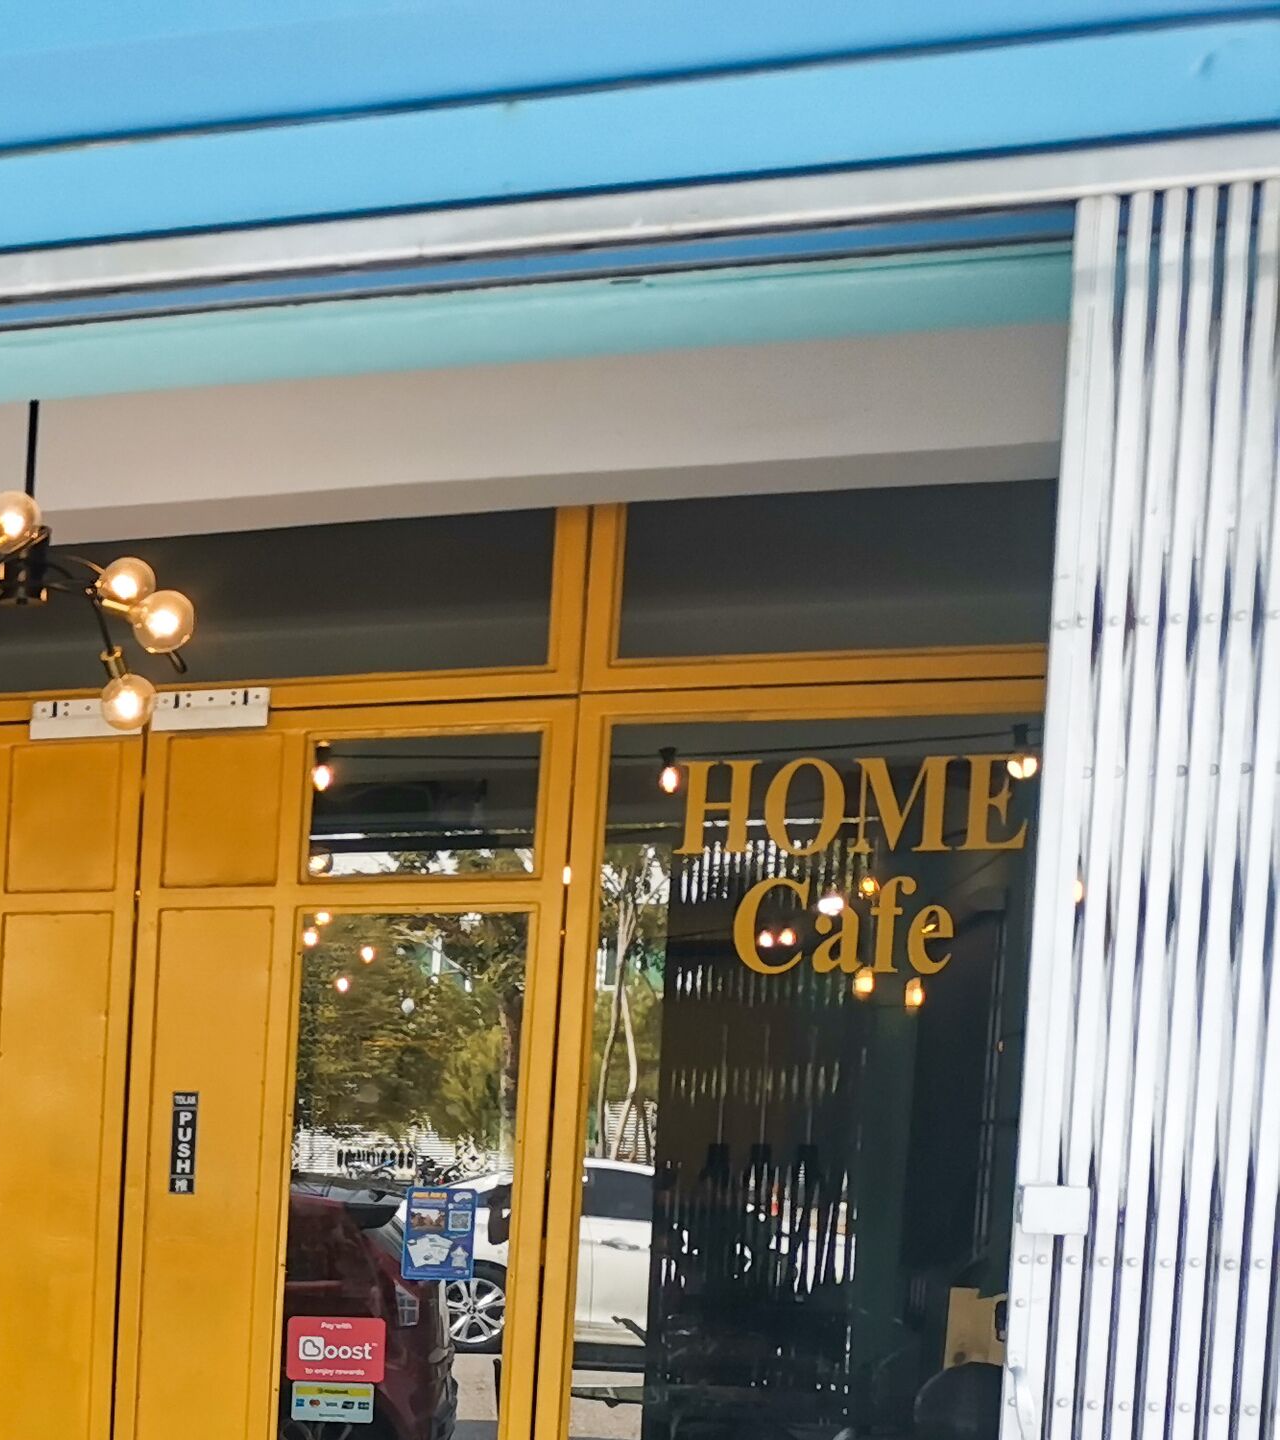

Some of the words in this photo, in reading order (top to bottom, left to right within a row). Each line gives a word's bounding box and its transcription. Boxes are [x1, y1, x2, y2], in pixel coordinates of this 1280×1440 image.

[673, 753, 1029, 856] HOME
[733, 875, 954, 975] Cafe
[176, 1111, 192, 1174] PUSH
[299, 1336, 372, 1360] Boost
